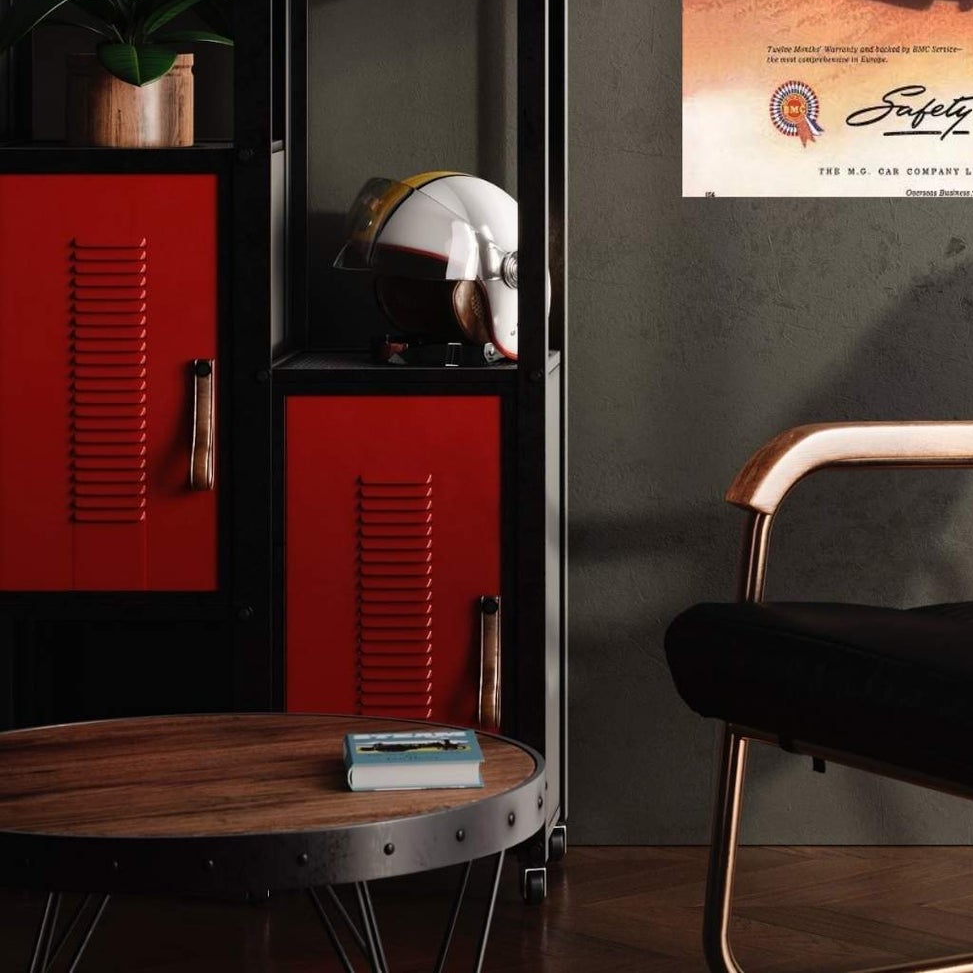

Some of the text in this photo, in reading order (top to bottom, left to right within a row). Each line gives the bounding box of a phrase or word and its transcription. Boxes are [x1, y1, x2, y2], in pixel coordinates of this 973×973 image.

[798, 56, 850, 64] comprehensive
[907, 168, 960, 176] COMPANY
[905, 189, 937, 197] Overseas
